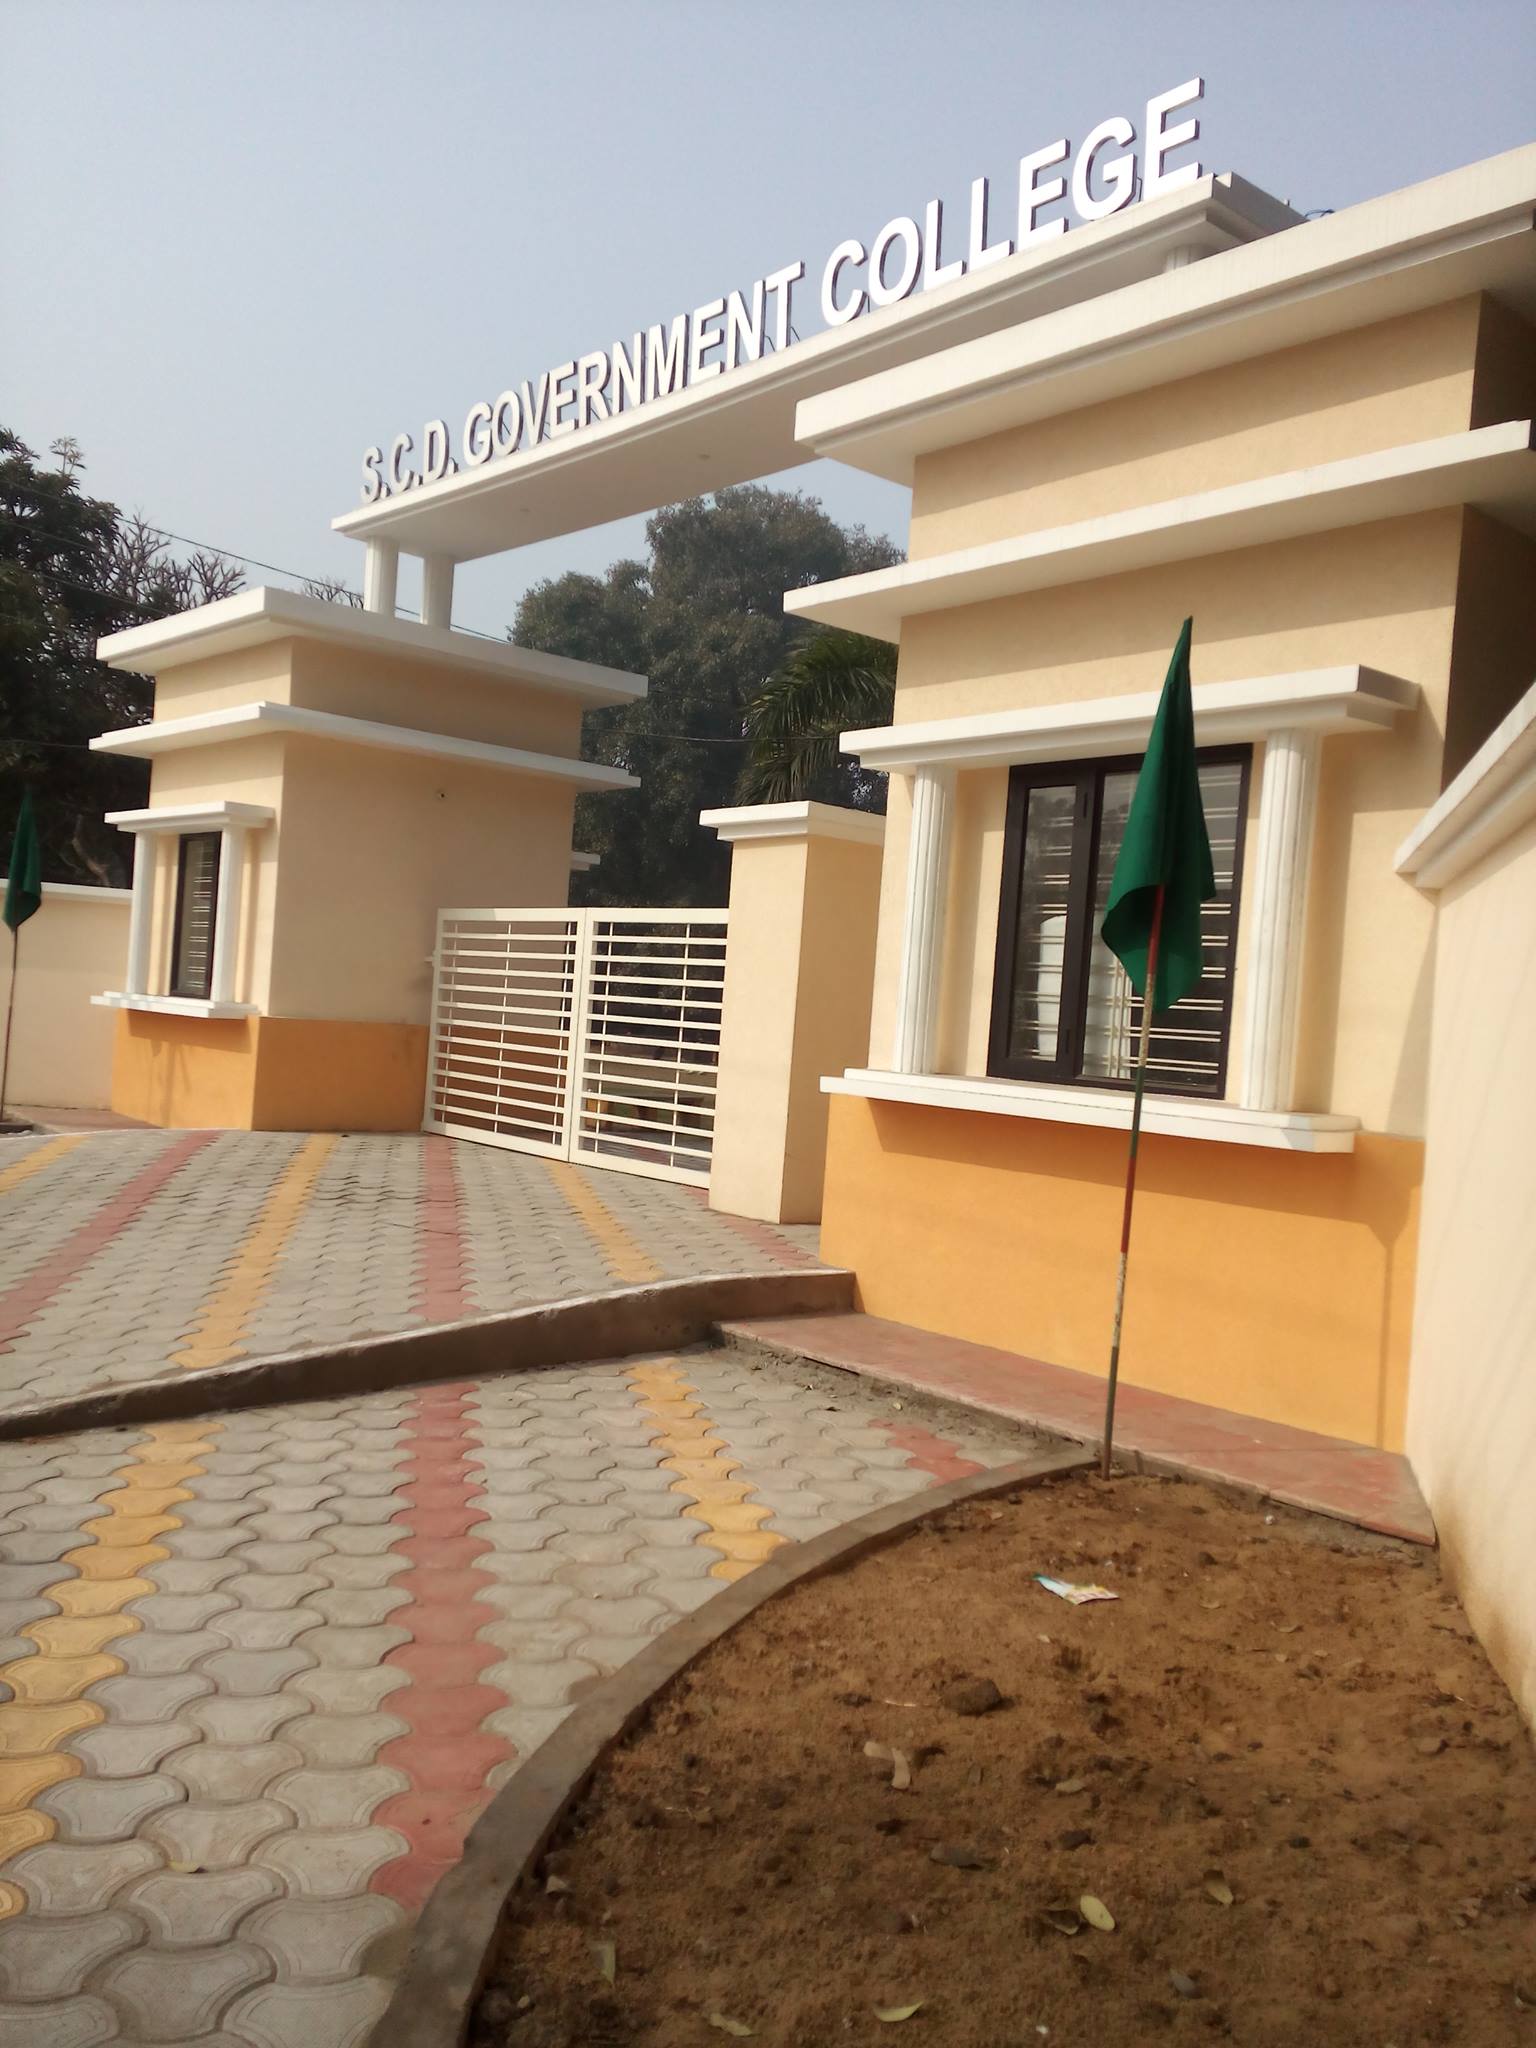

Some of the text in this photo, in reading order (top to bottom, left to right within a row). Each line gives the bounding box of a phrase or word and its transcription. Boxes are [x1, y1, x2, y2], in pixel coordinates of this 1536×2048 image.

[361, 77, 1205, 503] S.C.D. GOVERNMENT COLLEGE
